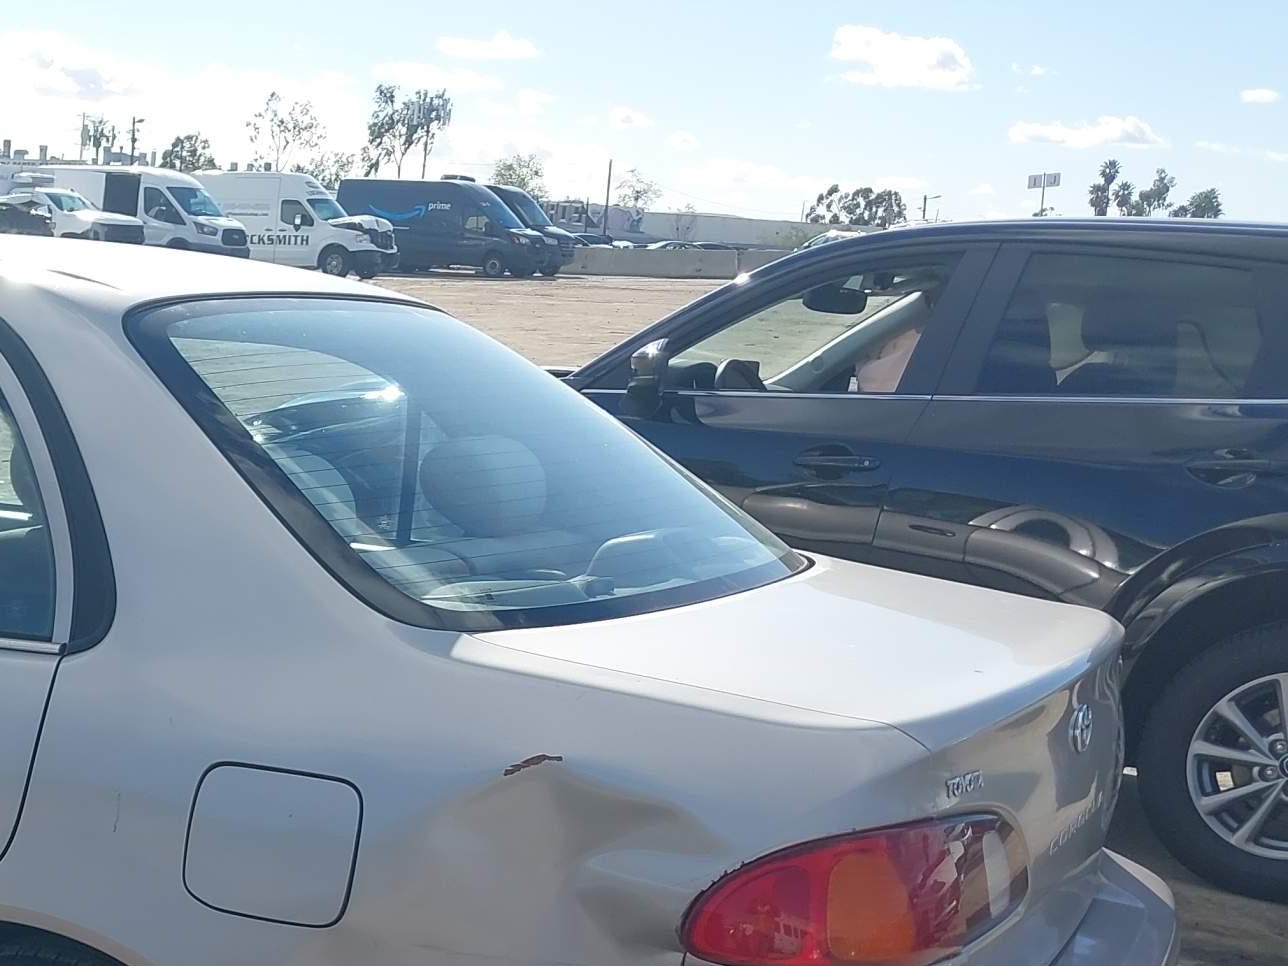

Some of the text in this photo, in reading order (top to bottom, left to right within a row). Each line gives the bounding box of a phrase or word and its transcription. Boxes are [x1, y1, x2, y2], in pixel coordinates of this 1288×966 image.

[428, 202, 452, 211] prime
[247, 234, 310, 246] CKSMITH
[945, 770, 985, 799] TOYOTA
